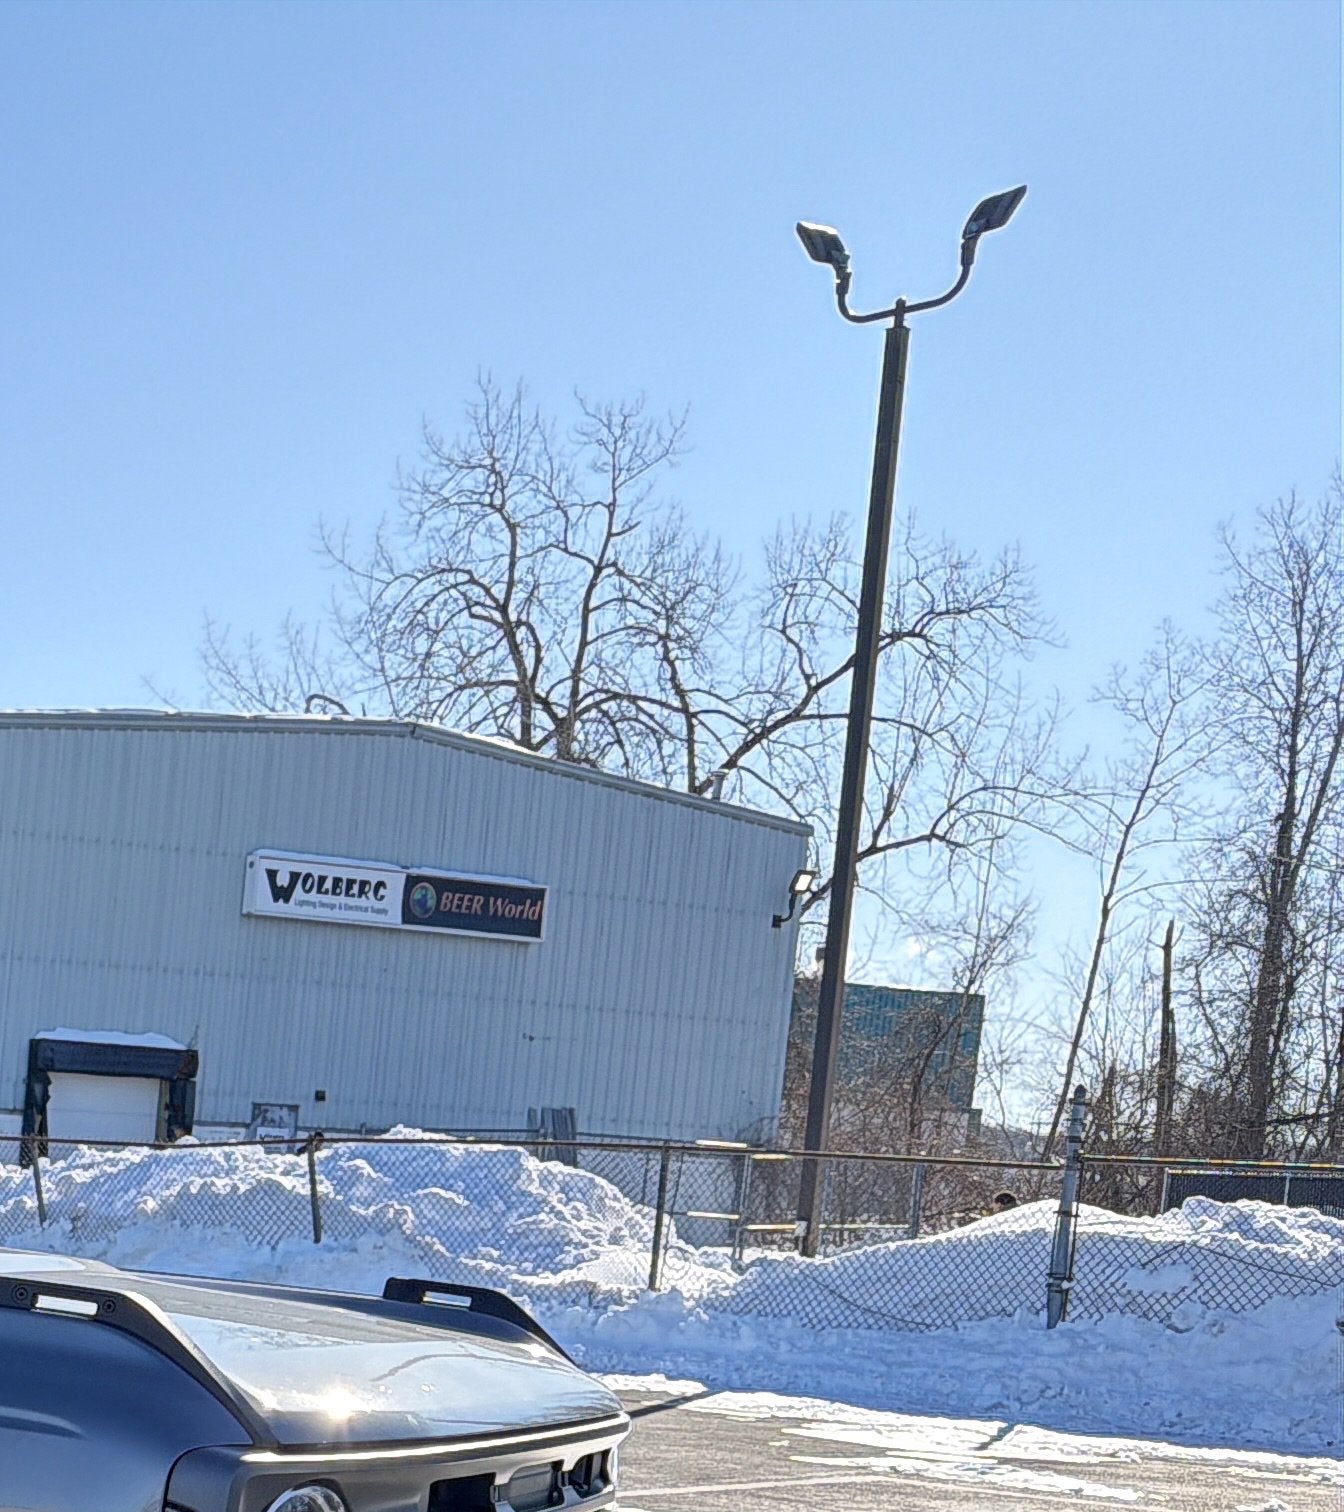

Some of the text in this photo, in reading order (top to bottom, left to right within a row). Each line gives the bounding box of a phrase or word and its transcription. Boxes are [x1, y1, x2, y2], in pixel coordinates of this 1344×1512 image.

[265, 868, 388, 904] WOLBERG
[440, 892, 542, 920] BEER World
